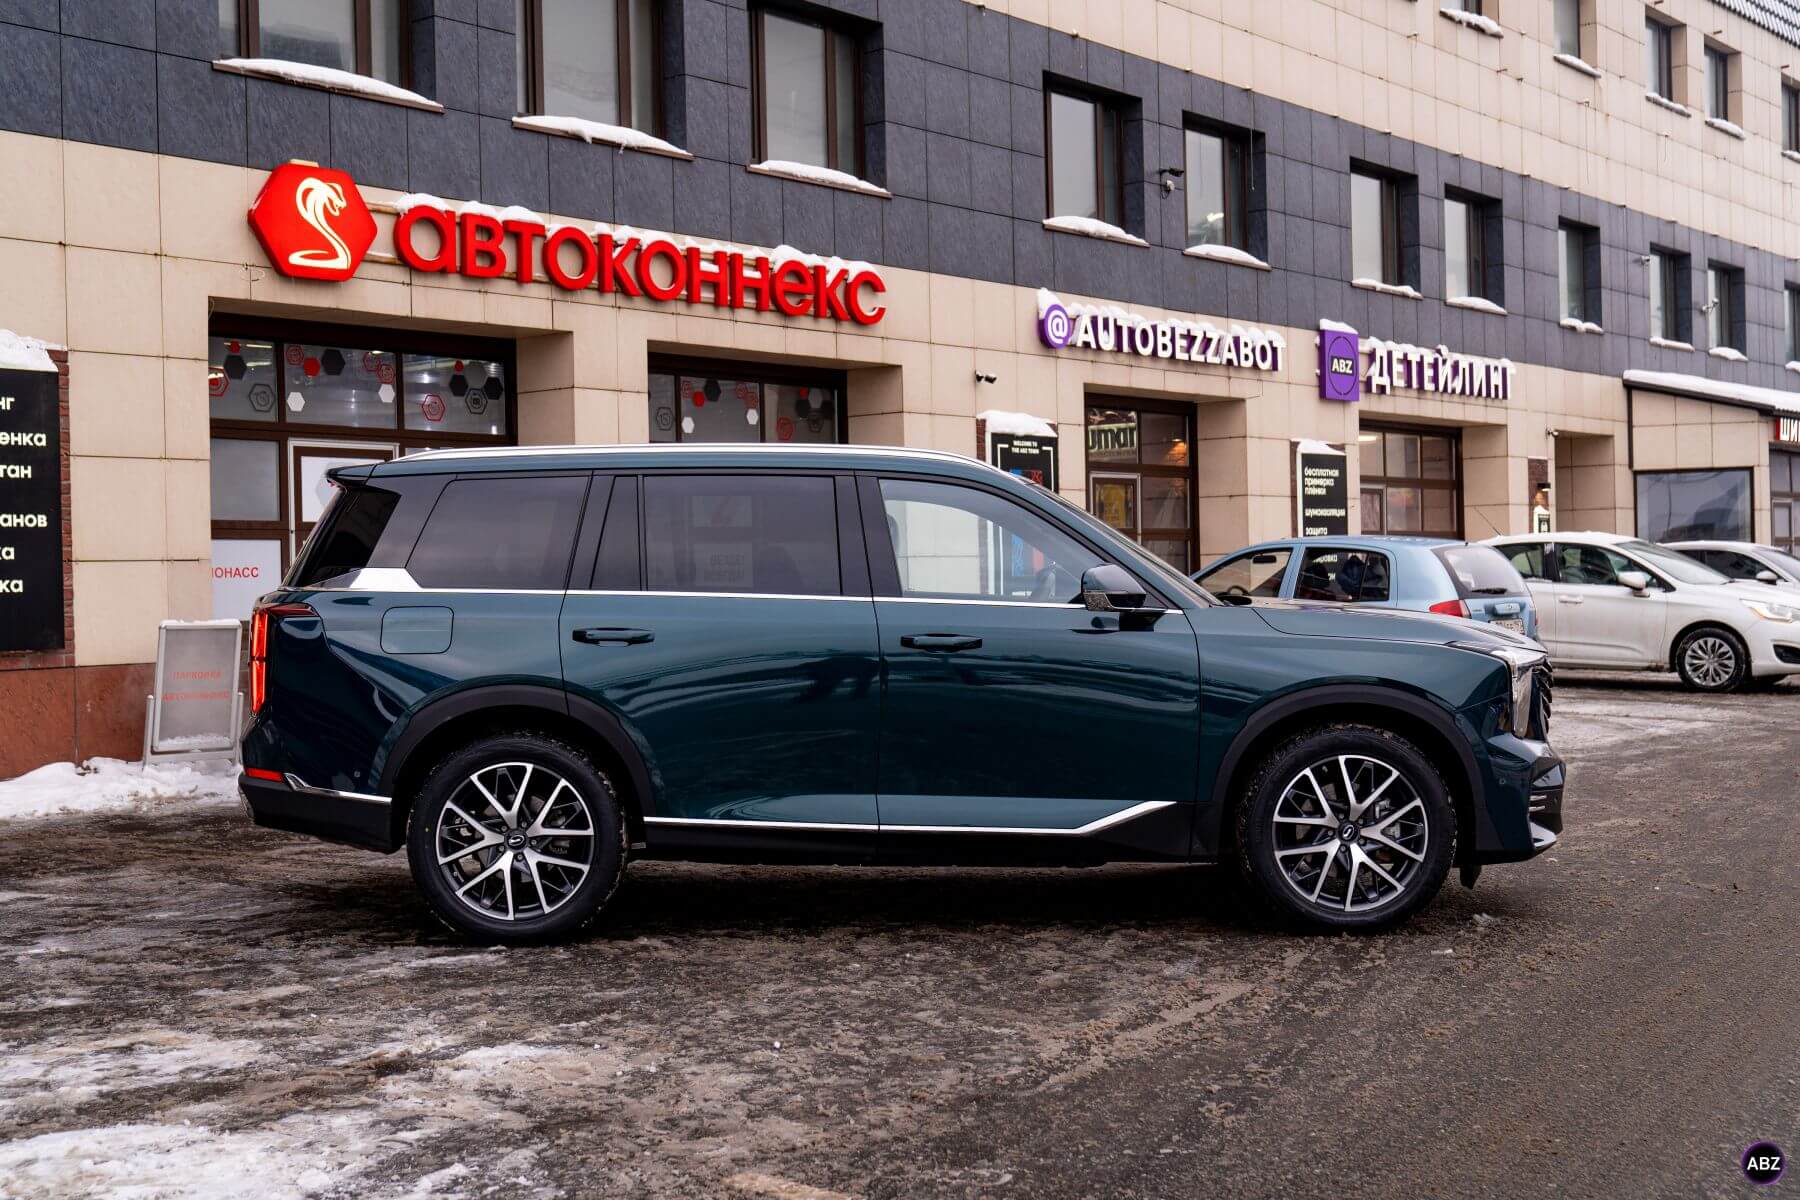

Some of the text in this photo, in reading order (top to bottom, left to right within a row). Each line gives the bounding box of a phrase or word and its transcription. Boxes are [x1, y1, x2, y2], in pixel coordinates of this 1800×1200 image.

[1077, 314, 1286, 371] AUTOBEZZABOT
[1331, 358, 1353, 374] ABZ
[1371, 344, 1516, 400] ДЕТЕЙЛИНГ
[1780, 417, 1800, 442] ШИ
[211, 567, 259, 578] ОНАСС
